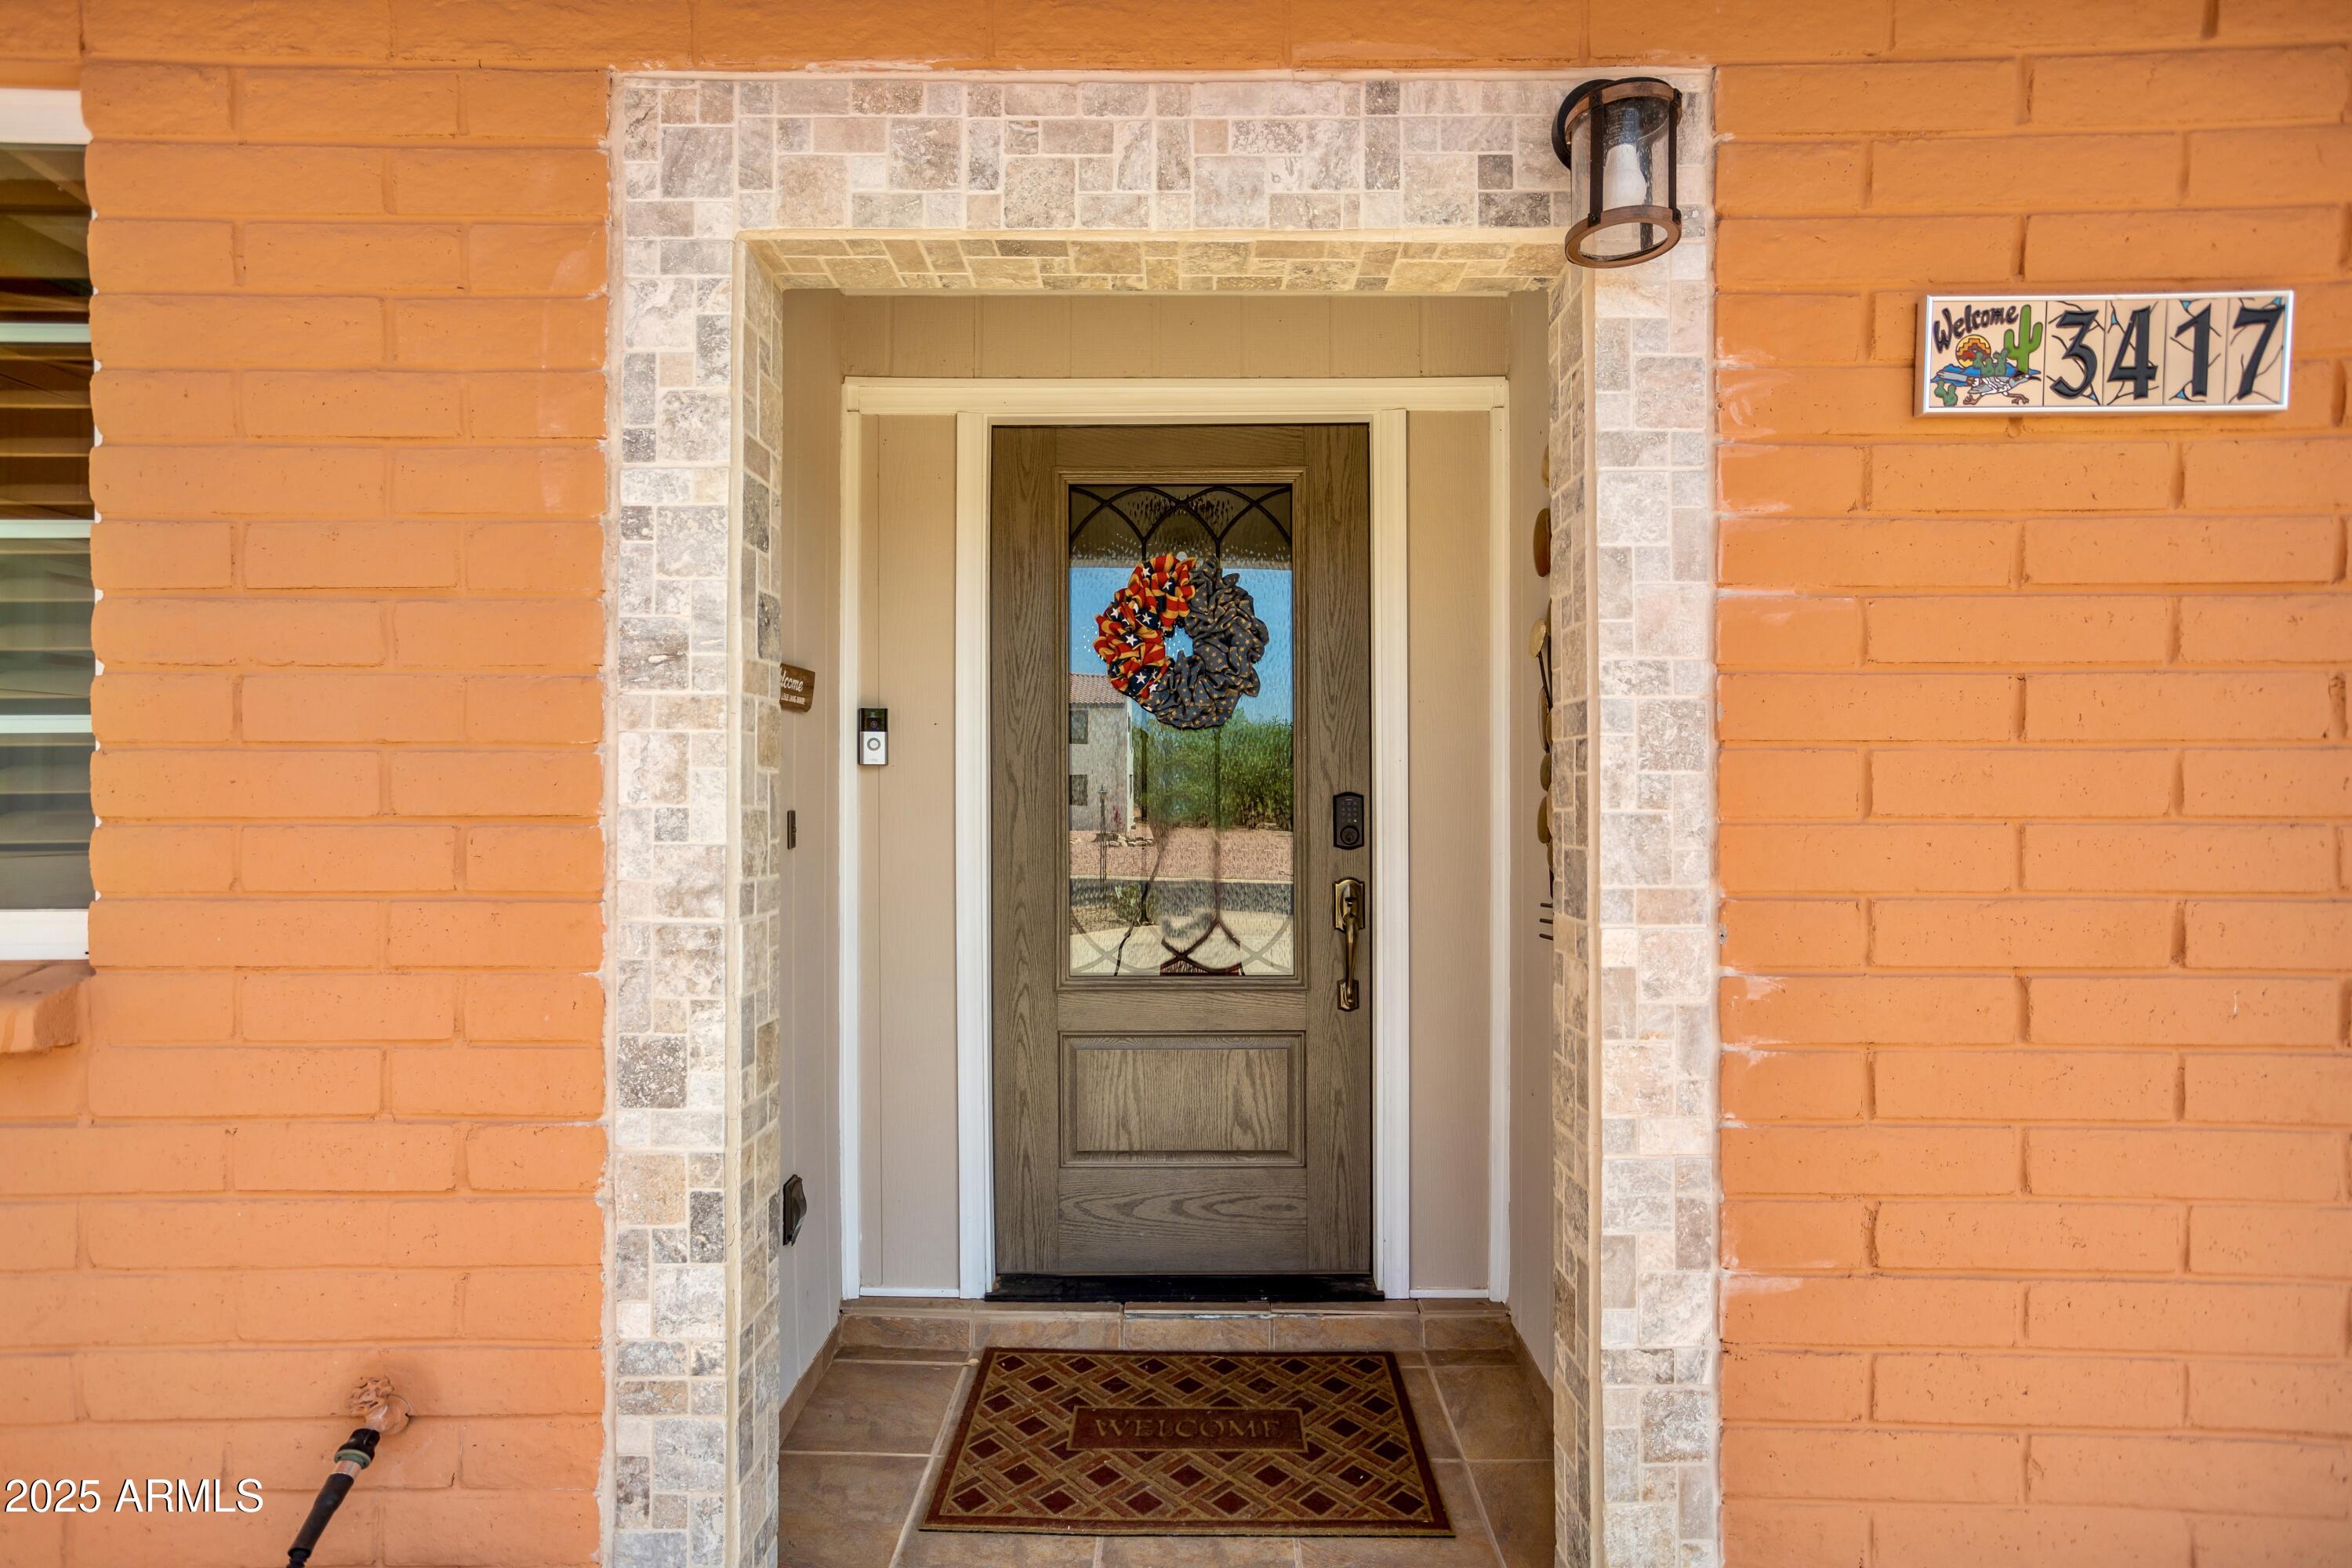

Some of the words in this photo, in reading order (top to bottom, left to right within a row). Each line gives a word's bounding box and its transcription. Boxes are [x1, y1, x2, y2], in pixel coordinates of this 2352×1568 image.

[1933, 303, 2020, 354] Welcome
[2048, 302, 2285, 401] 3417
[1094, 1418, 1280, 1439] WELCOME
